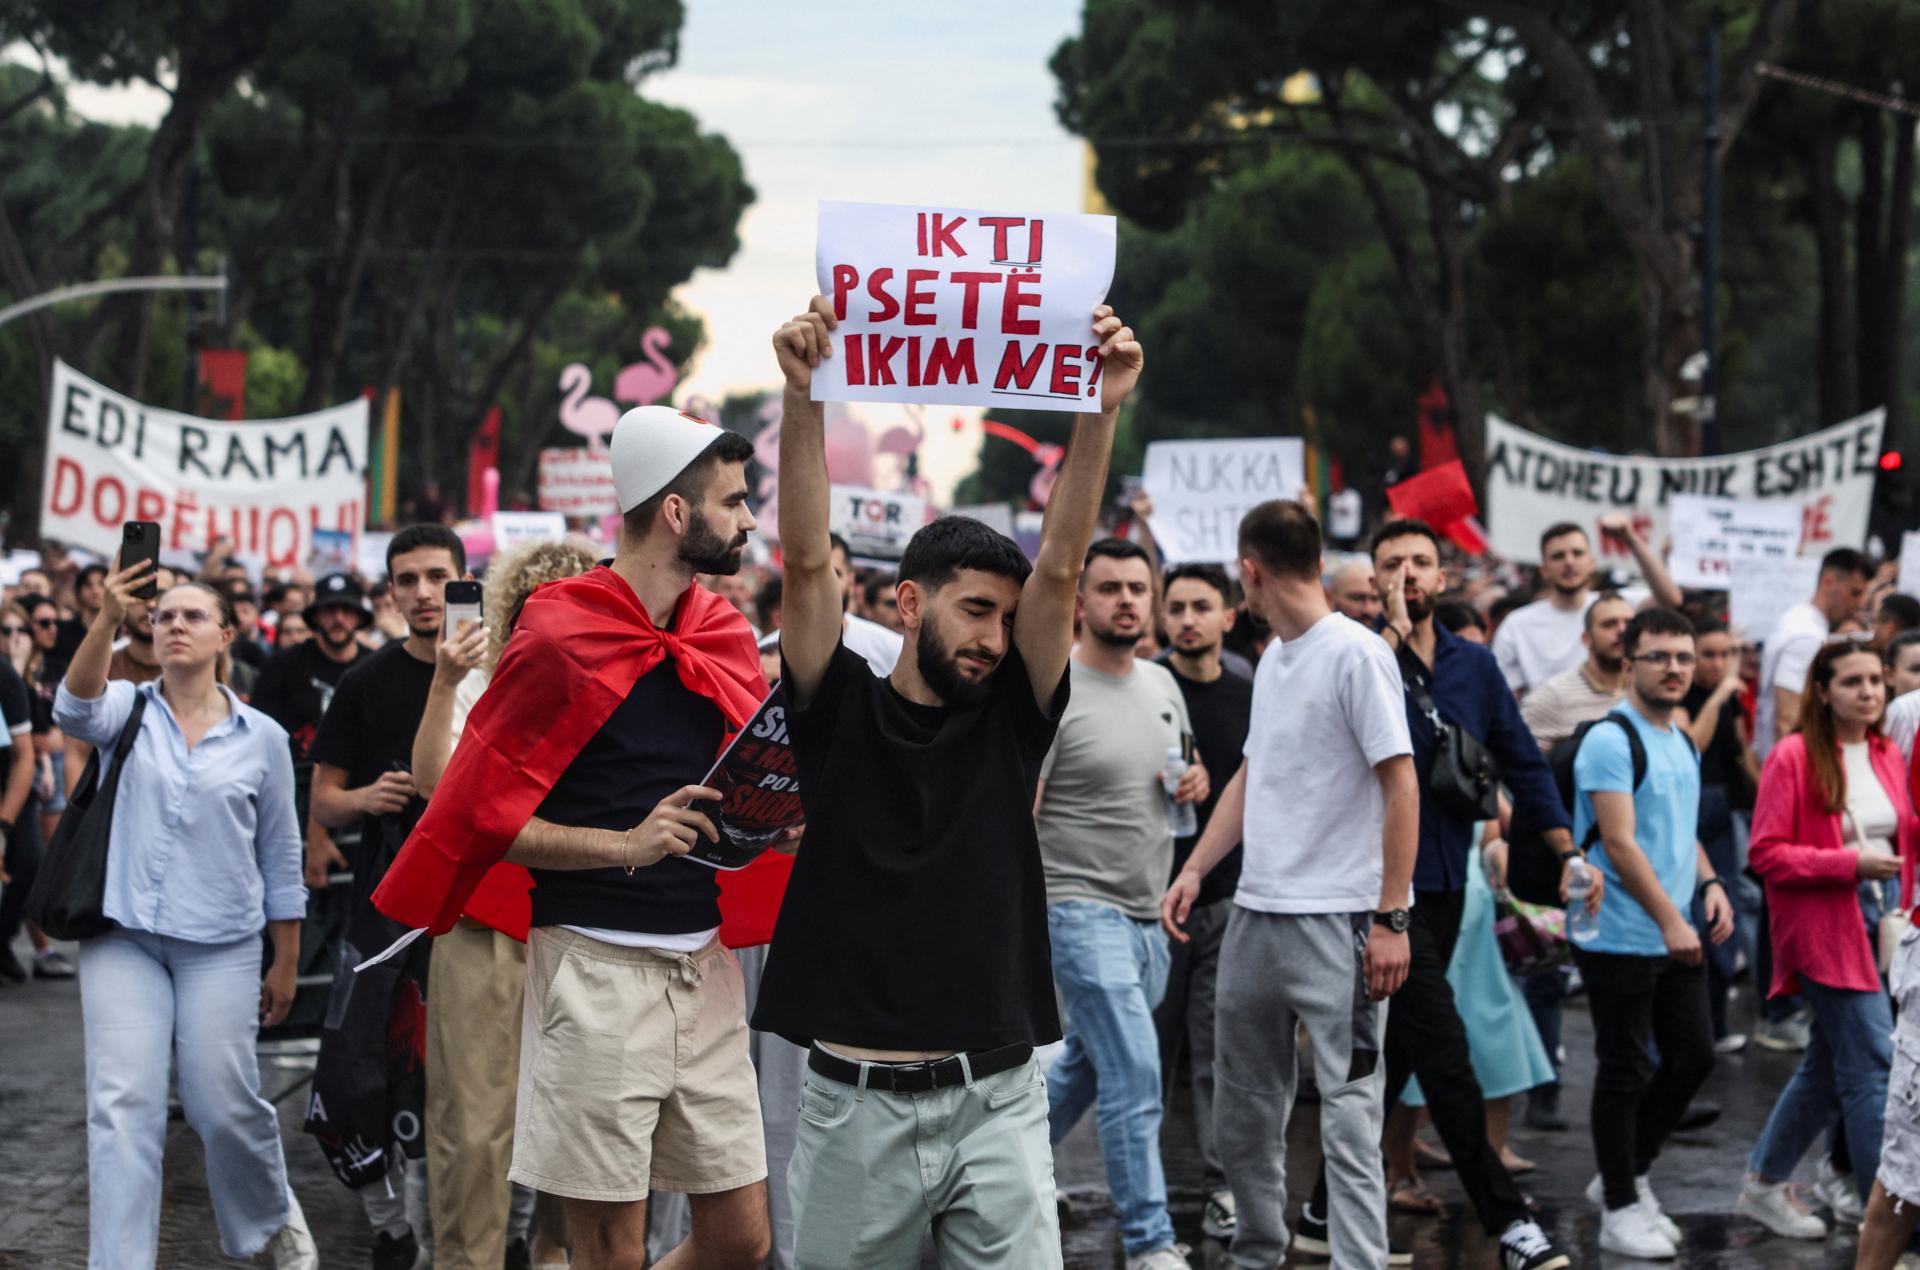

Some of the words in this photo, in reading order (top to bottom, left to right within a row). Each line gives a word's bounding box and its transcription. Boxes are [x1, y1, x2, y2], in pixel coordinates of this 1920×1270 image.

[916, 212, 968, 258] IK
[978, 216, 1044, 264] TI
[832, 263, 1043, 336] PSETË
[844, 333, 979, 387] IKIM
[993, 340, 1102, 398] NE?
[61, 384, 146, 459] EDI
[178, 423, 357, 480] RAMA
[1169, 452, 1234, 493] NUK
[1241, 451, 1285, 493] KA
[1487, 440, 1642, 508] ATDHEU
[1176, 504, 1252, 553] SHT
